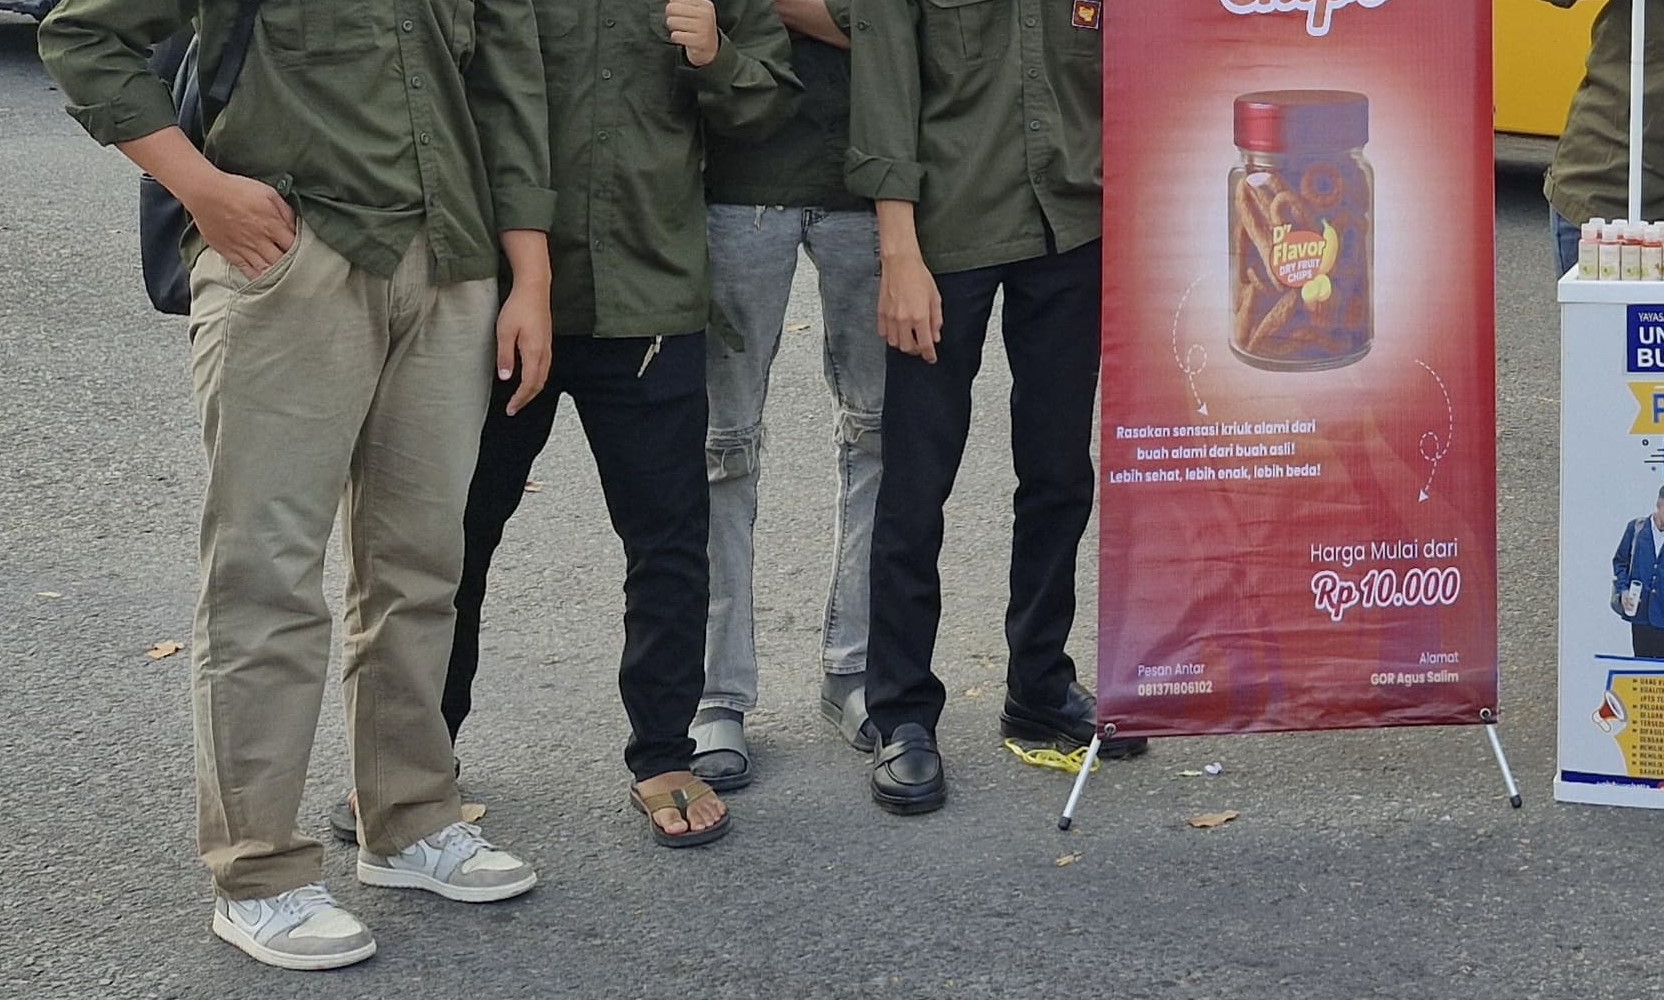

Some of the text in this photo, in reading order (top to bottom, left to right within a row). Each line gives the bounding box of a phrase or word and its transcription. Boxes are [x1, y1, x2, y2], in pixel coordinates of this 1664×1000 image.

[1273, 240, 1326, 266] Flavor
[1279, 259, 1320, 276] DRY FRUIT
[1287, 270, 1312, 283] CHIPS
[1117, 420, 1316, 439] Rasakan sensasi kriuk alami dari
[1137, 442, 1295, 460] buah alami dari buah asli!
[1110, 464, 1321, 484] Lebih sehat, lebih enak, lebih beda!
[1311, 538, 1457, 567] Harga Mulai dari
[1419, 651, 1458, 665] Alamat
[1138, 663, 1205, 676] Pesan Antar
[1371, 671, 1458, 688] GOR Agus Salim
